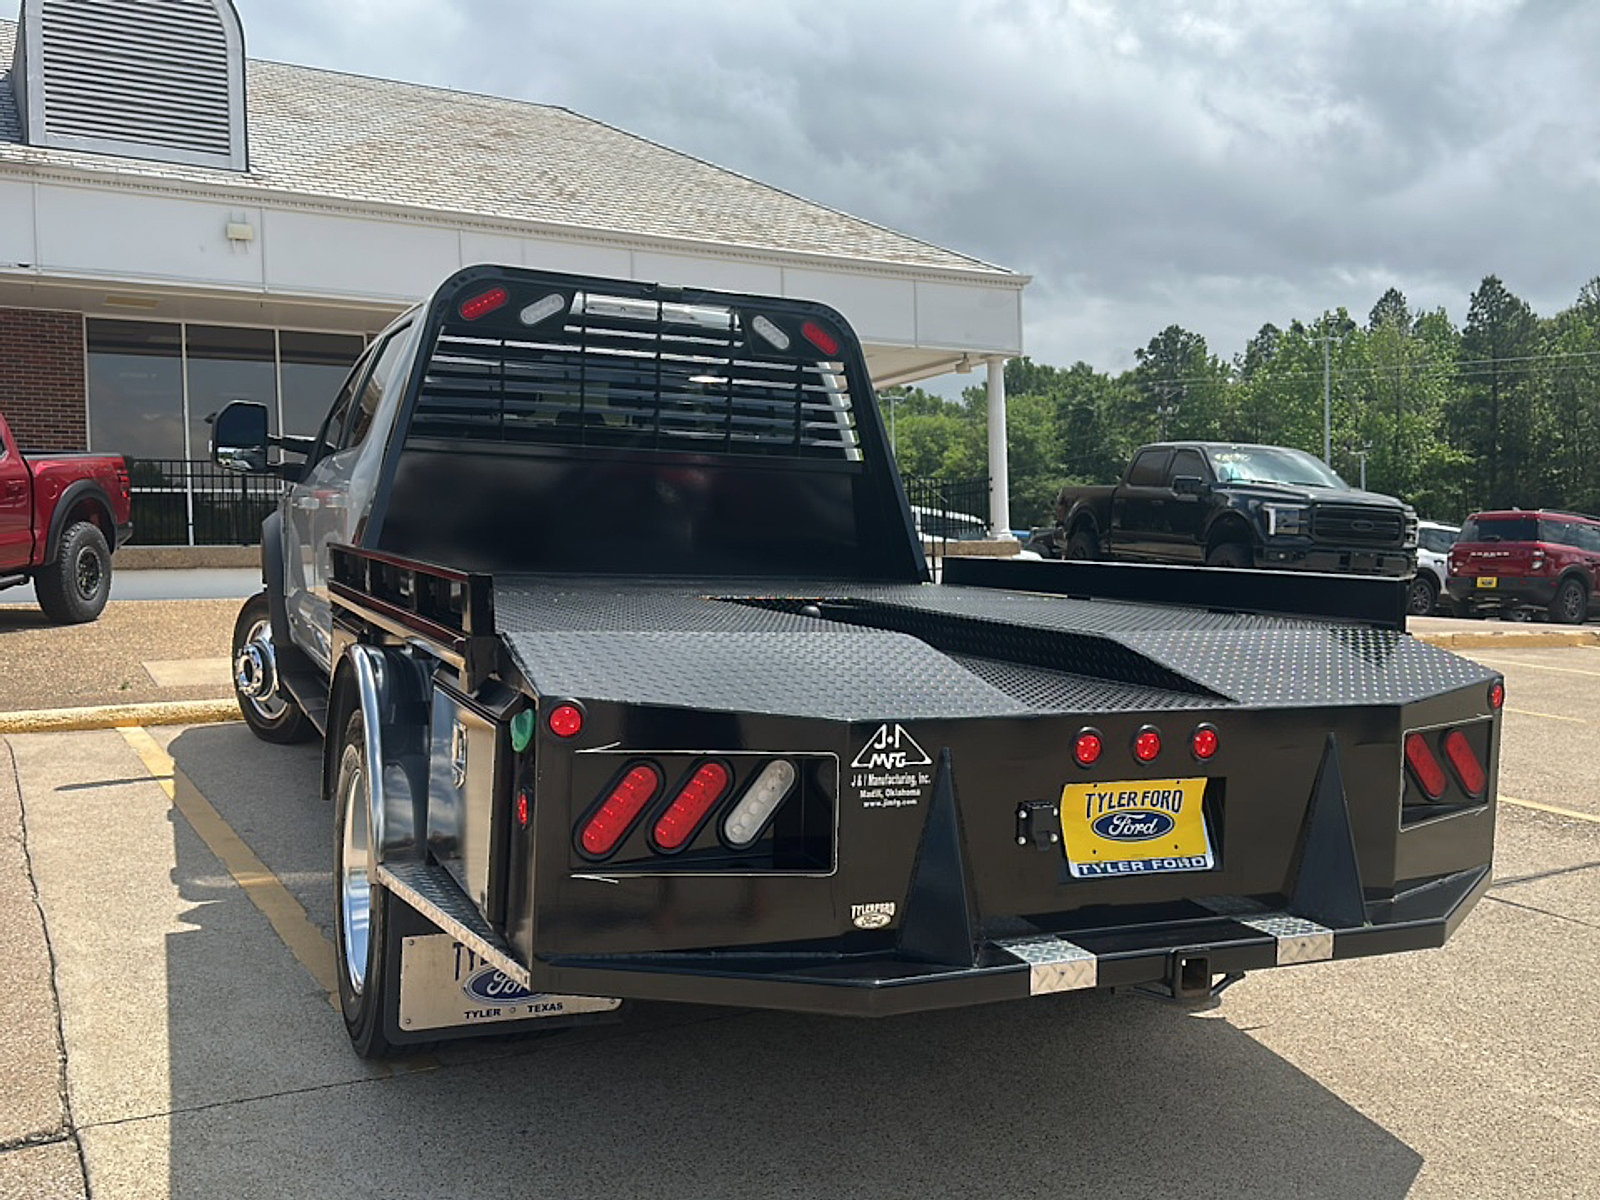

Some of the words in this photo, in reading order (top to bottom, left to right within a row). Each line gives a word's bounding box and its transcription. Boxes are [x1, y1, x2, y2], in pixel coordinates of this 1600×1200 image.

[868, 751, 907, 770] MFG
[885, 788, 921, 797] Oklahoma
[1085, 790, 1138, 820] TYLER
[1140, 789, 1184, 814] FORD
[1108, 813, 1159, 836] Ford
[1078, 860, 1145, 875] TYLER
[1151, 857, 1206, 870] FORD
[464, 1008, 501, 1019] TYLER
[527, 1002, 563, 1013] TEXAS
